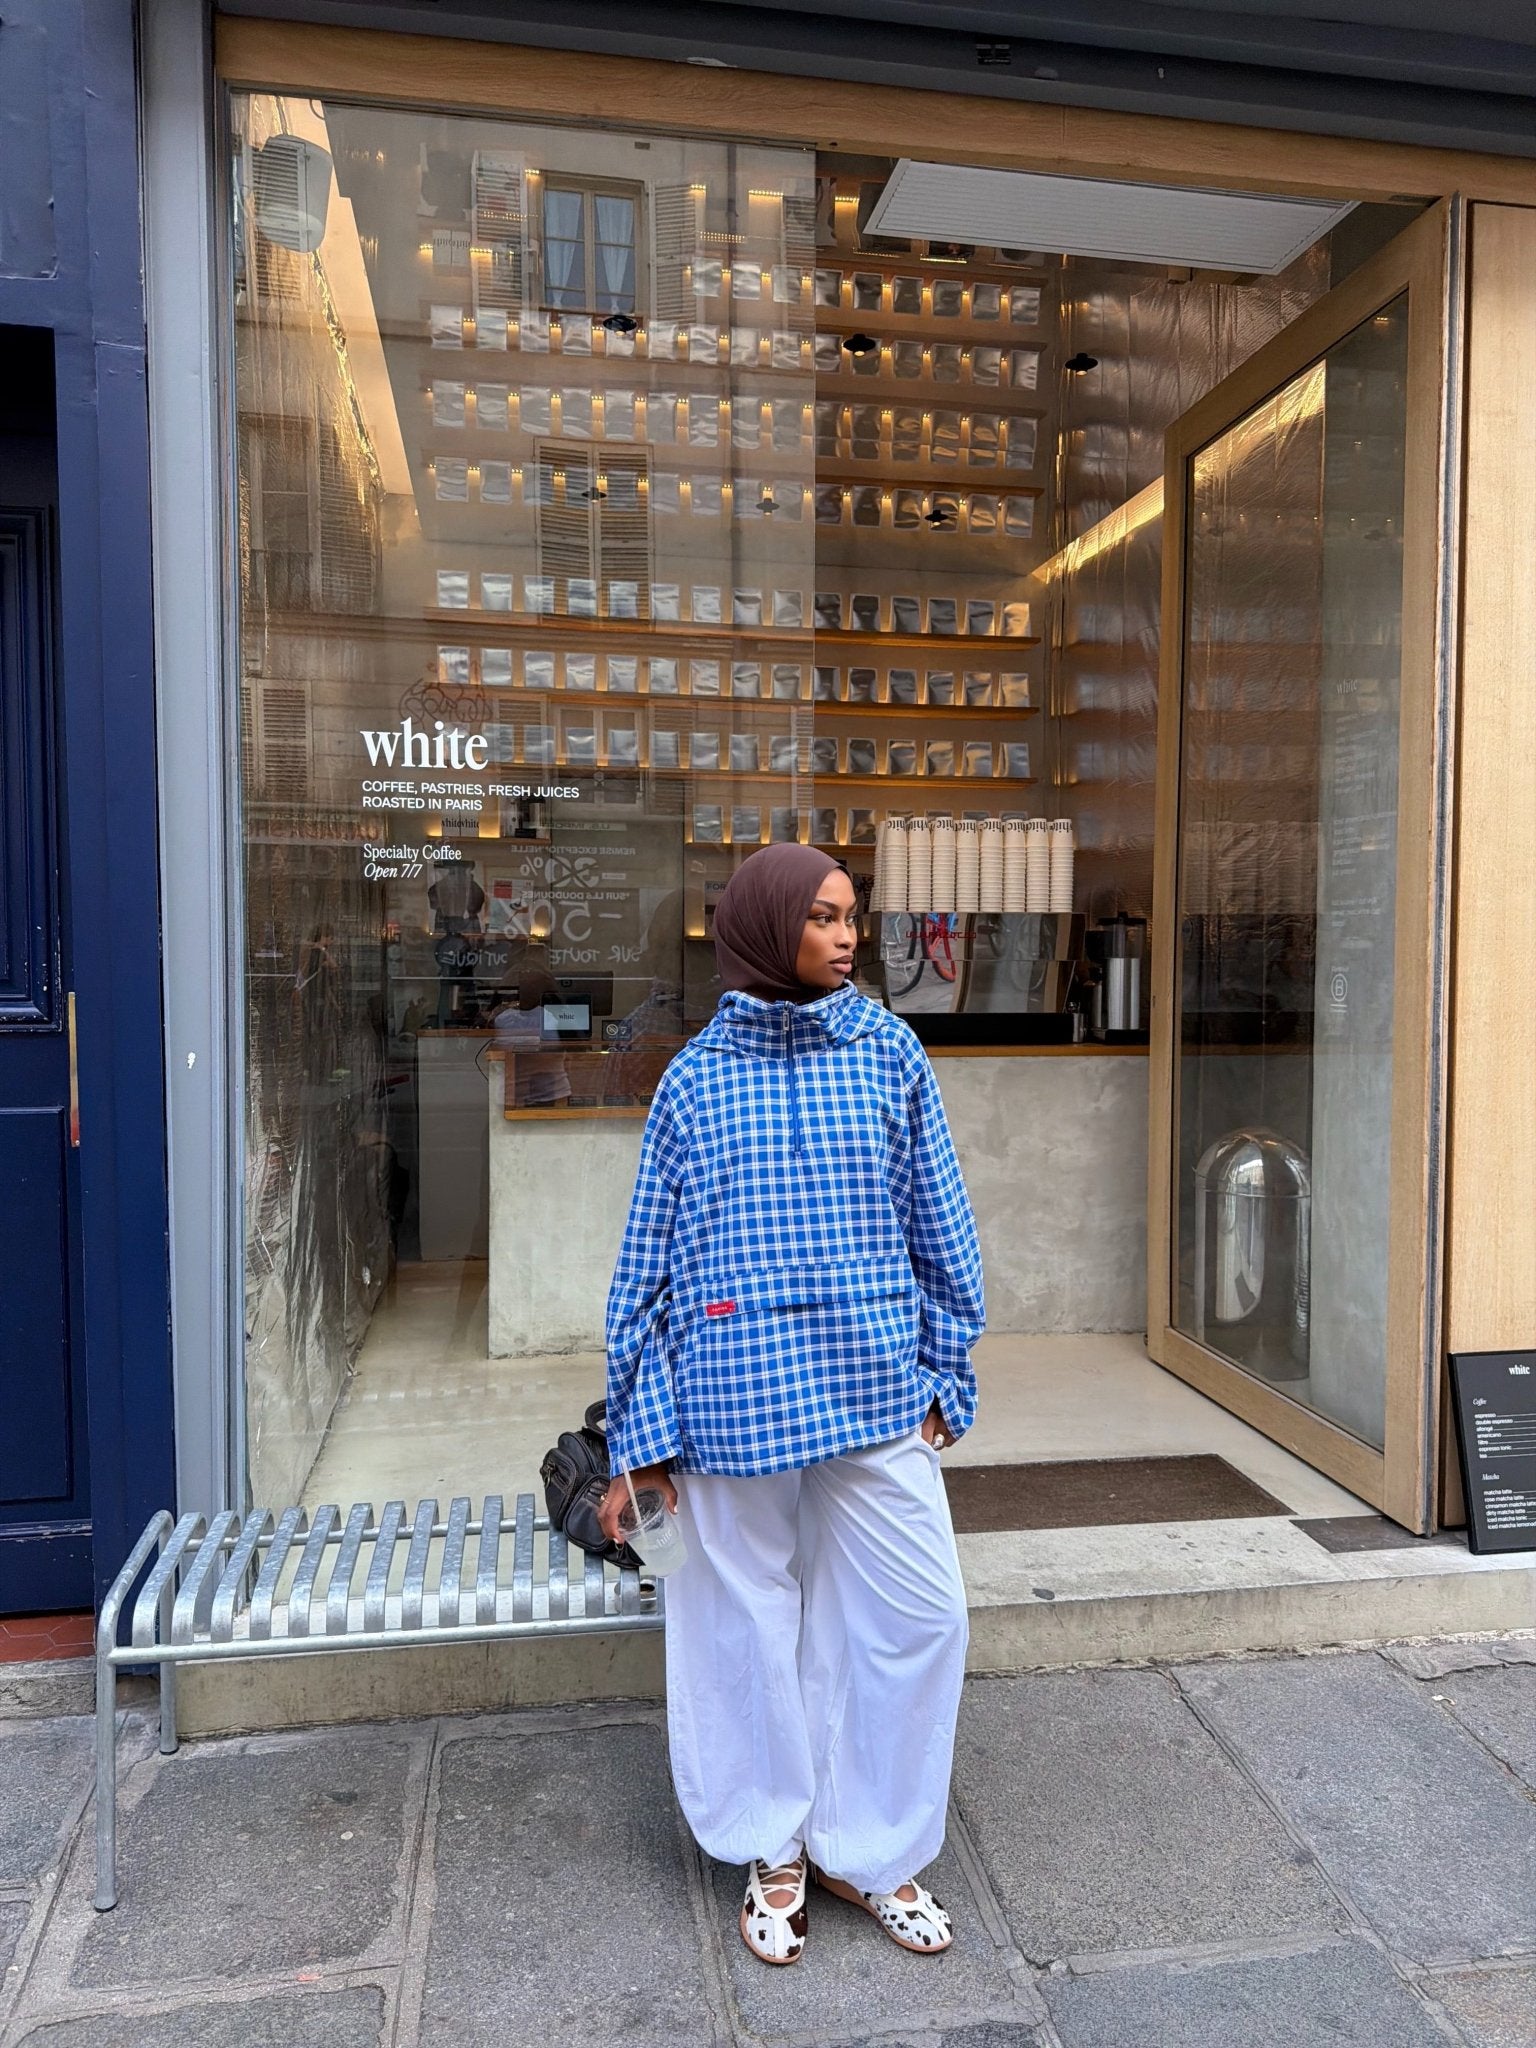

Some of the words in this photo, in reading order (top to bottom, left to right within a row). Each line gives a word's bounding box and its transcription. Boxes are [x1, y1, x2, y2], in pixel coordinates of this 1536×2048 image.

[361, 716, 489, 770] white
[362, 780, 418, 795] COFFEE,
[421, 783, 486, 798] PASTRIES,
[489, 785, 531, 798] FRESH
[534, 786, 580, 799] JUICES
[362, 796, 425, 810] ROASTED
[429, 799, 442, 810] IN
[445, 799, 483, 811] PARIS
[364, 843, 420, 863] Specialty
[422, 845, 462, 861] Coffee
[364, 862, 398, 881] Open
[401, 862, 423, 879] 7/7
[1508, 1364, 1531, 1375] white
